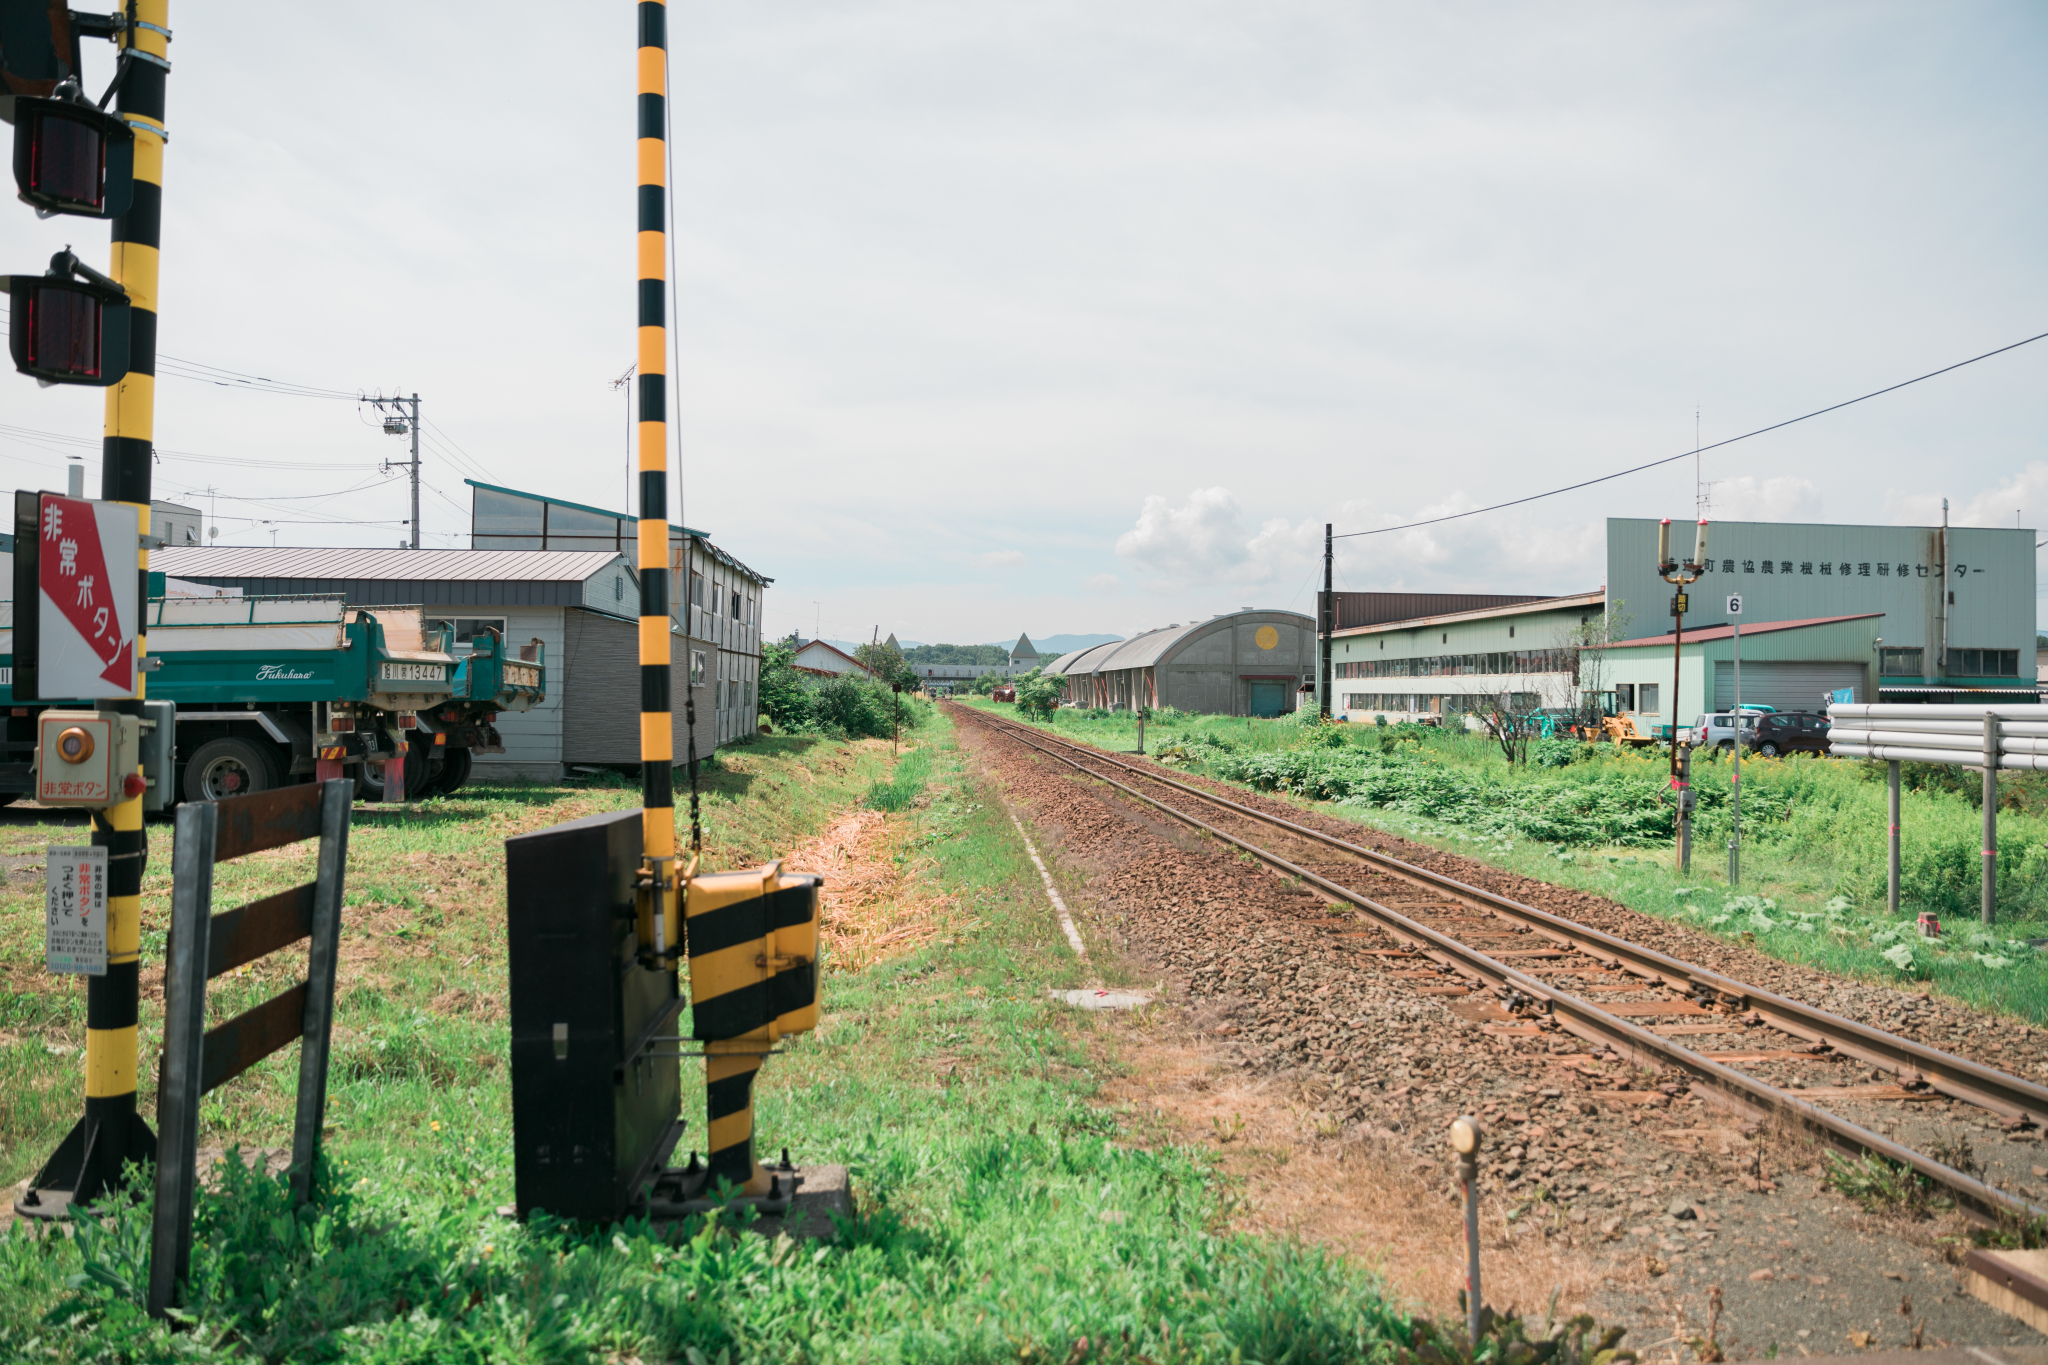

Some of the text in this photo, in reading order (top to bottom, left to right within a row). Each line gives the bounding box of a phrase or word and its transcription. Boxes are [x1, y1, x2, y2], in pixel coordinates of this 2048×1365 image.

[1669, 556, 1986, 579] 町農協農業機械修理研修センター
[43, 502, 123, 667] 非常ボタン
[1677, 594, 1687, 612] 踏切
[1729, 597, 1740, 612] 6
[255, 663, 315, 681] Fukuhara
[43, 780, 107, 797] 非常ボタン
[62, 865, 74, 917] つよく押して
[50, 885, 59, 926] ください
